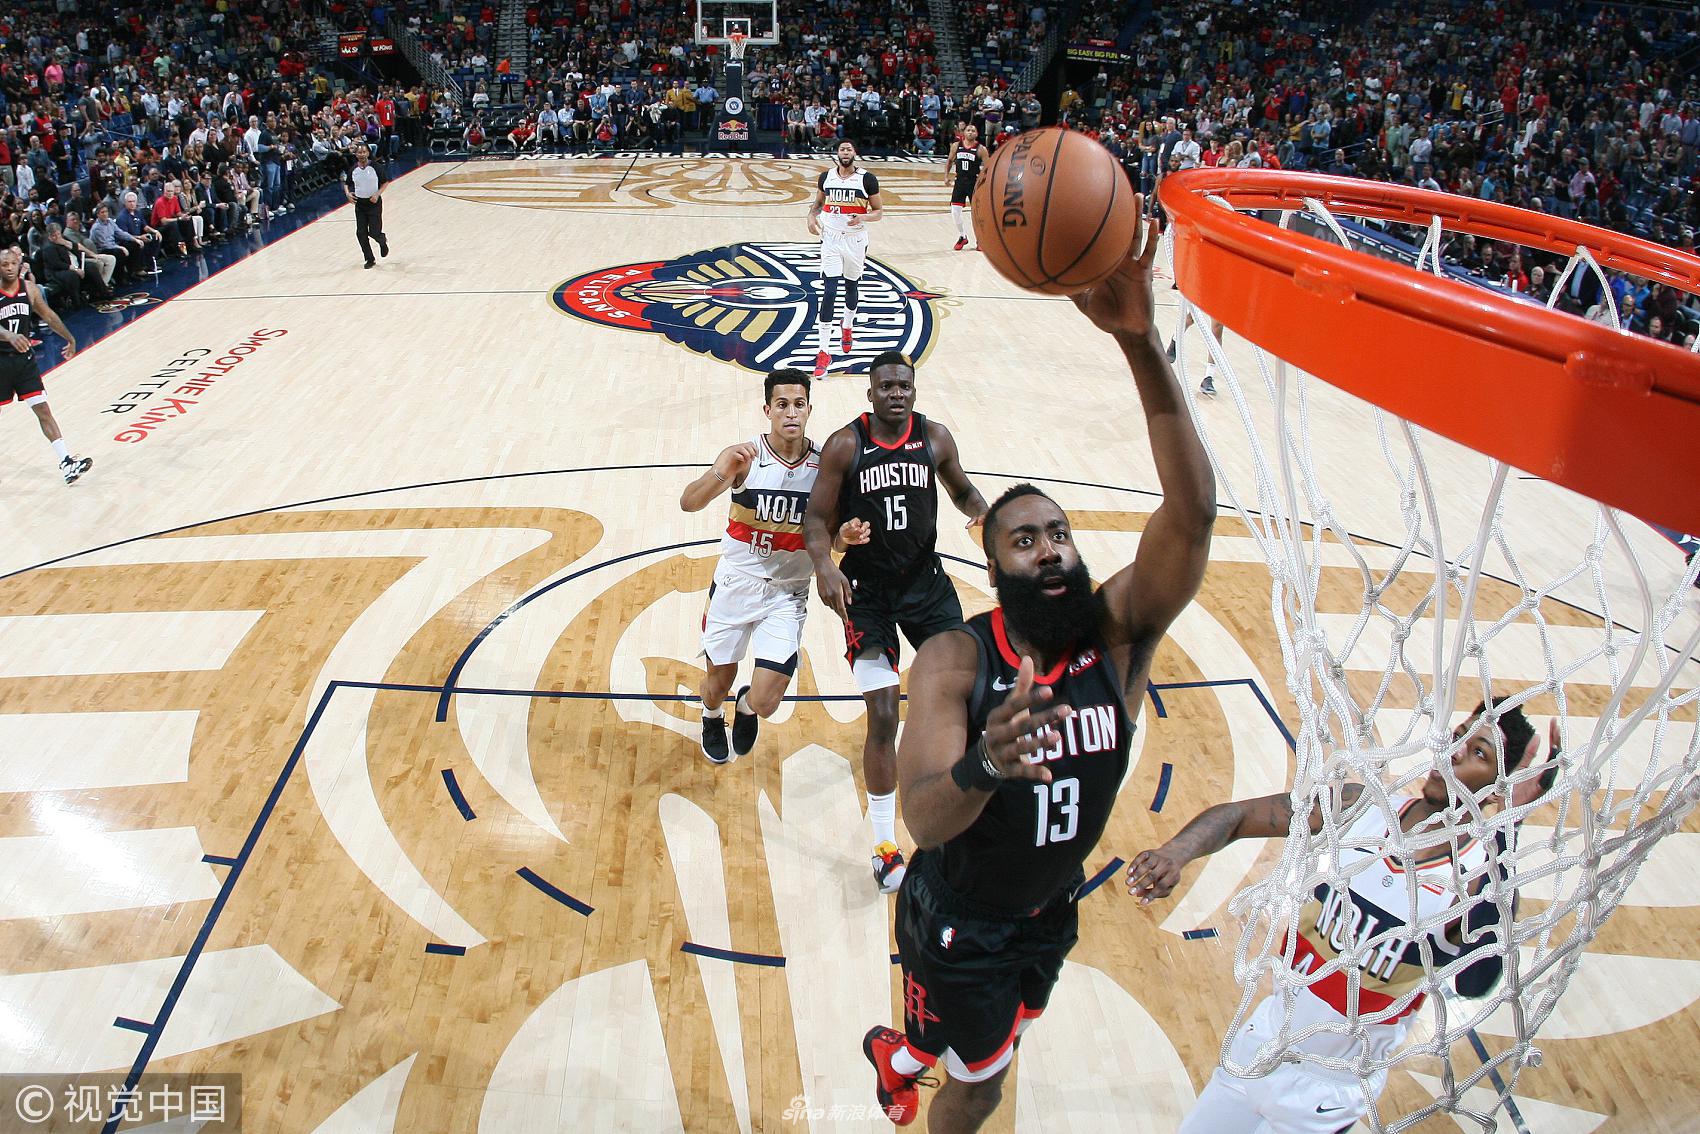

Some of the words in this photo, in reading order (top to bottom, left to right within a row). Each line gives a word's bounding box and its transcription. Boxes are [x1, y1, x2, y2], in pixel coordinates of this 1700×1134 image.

[1079, 49, 1094, 57] EASY
[718, 132, 734, 140] Red
[734, 132, 748, 140] Bull
[516, 152, 603, 160] NEW
[614, 152, 775, 160] ORLEANS
[962, 160, 969, 170] 10
[829, 188, 856, 203] NOLA
[829, 206, 841, 218] 23
[578, 269, 643, 318] PELICANS
[8, 319, 20, 334] 17
[172, 328, 288, 396] SMOOTHIE
[100, 348, 212, 414] CENTER
[859, 462, 929, 494] HOUSTON
[755, 493, 810, 526] NOL
[883, 494, 908, 531] 15
[749, 530, 774, 558] 15
[1023, 705, 1117, 764] USTON
[1033, 777, 1080, 847] 13
